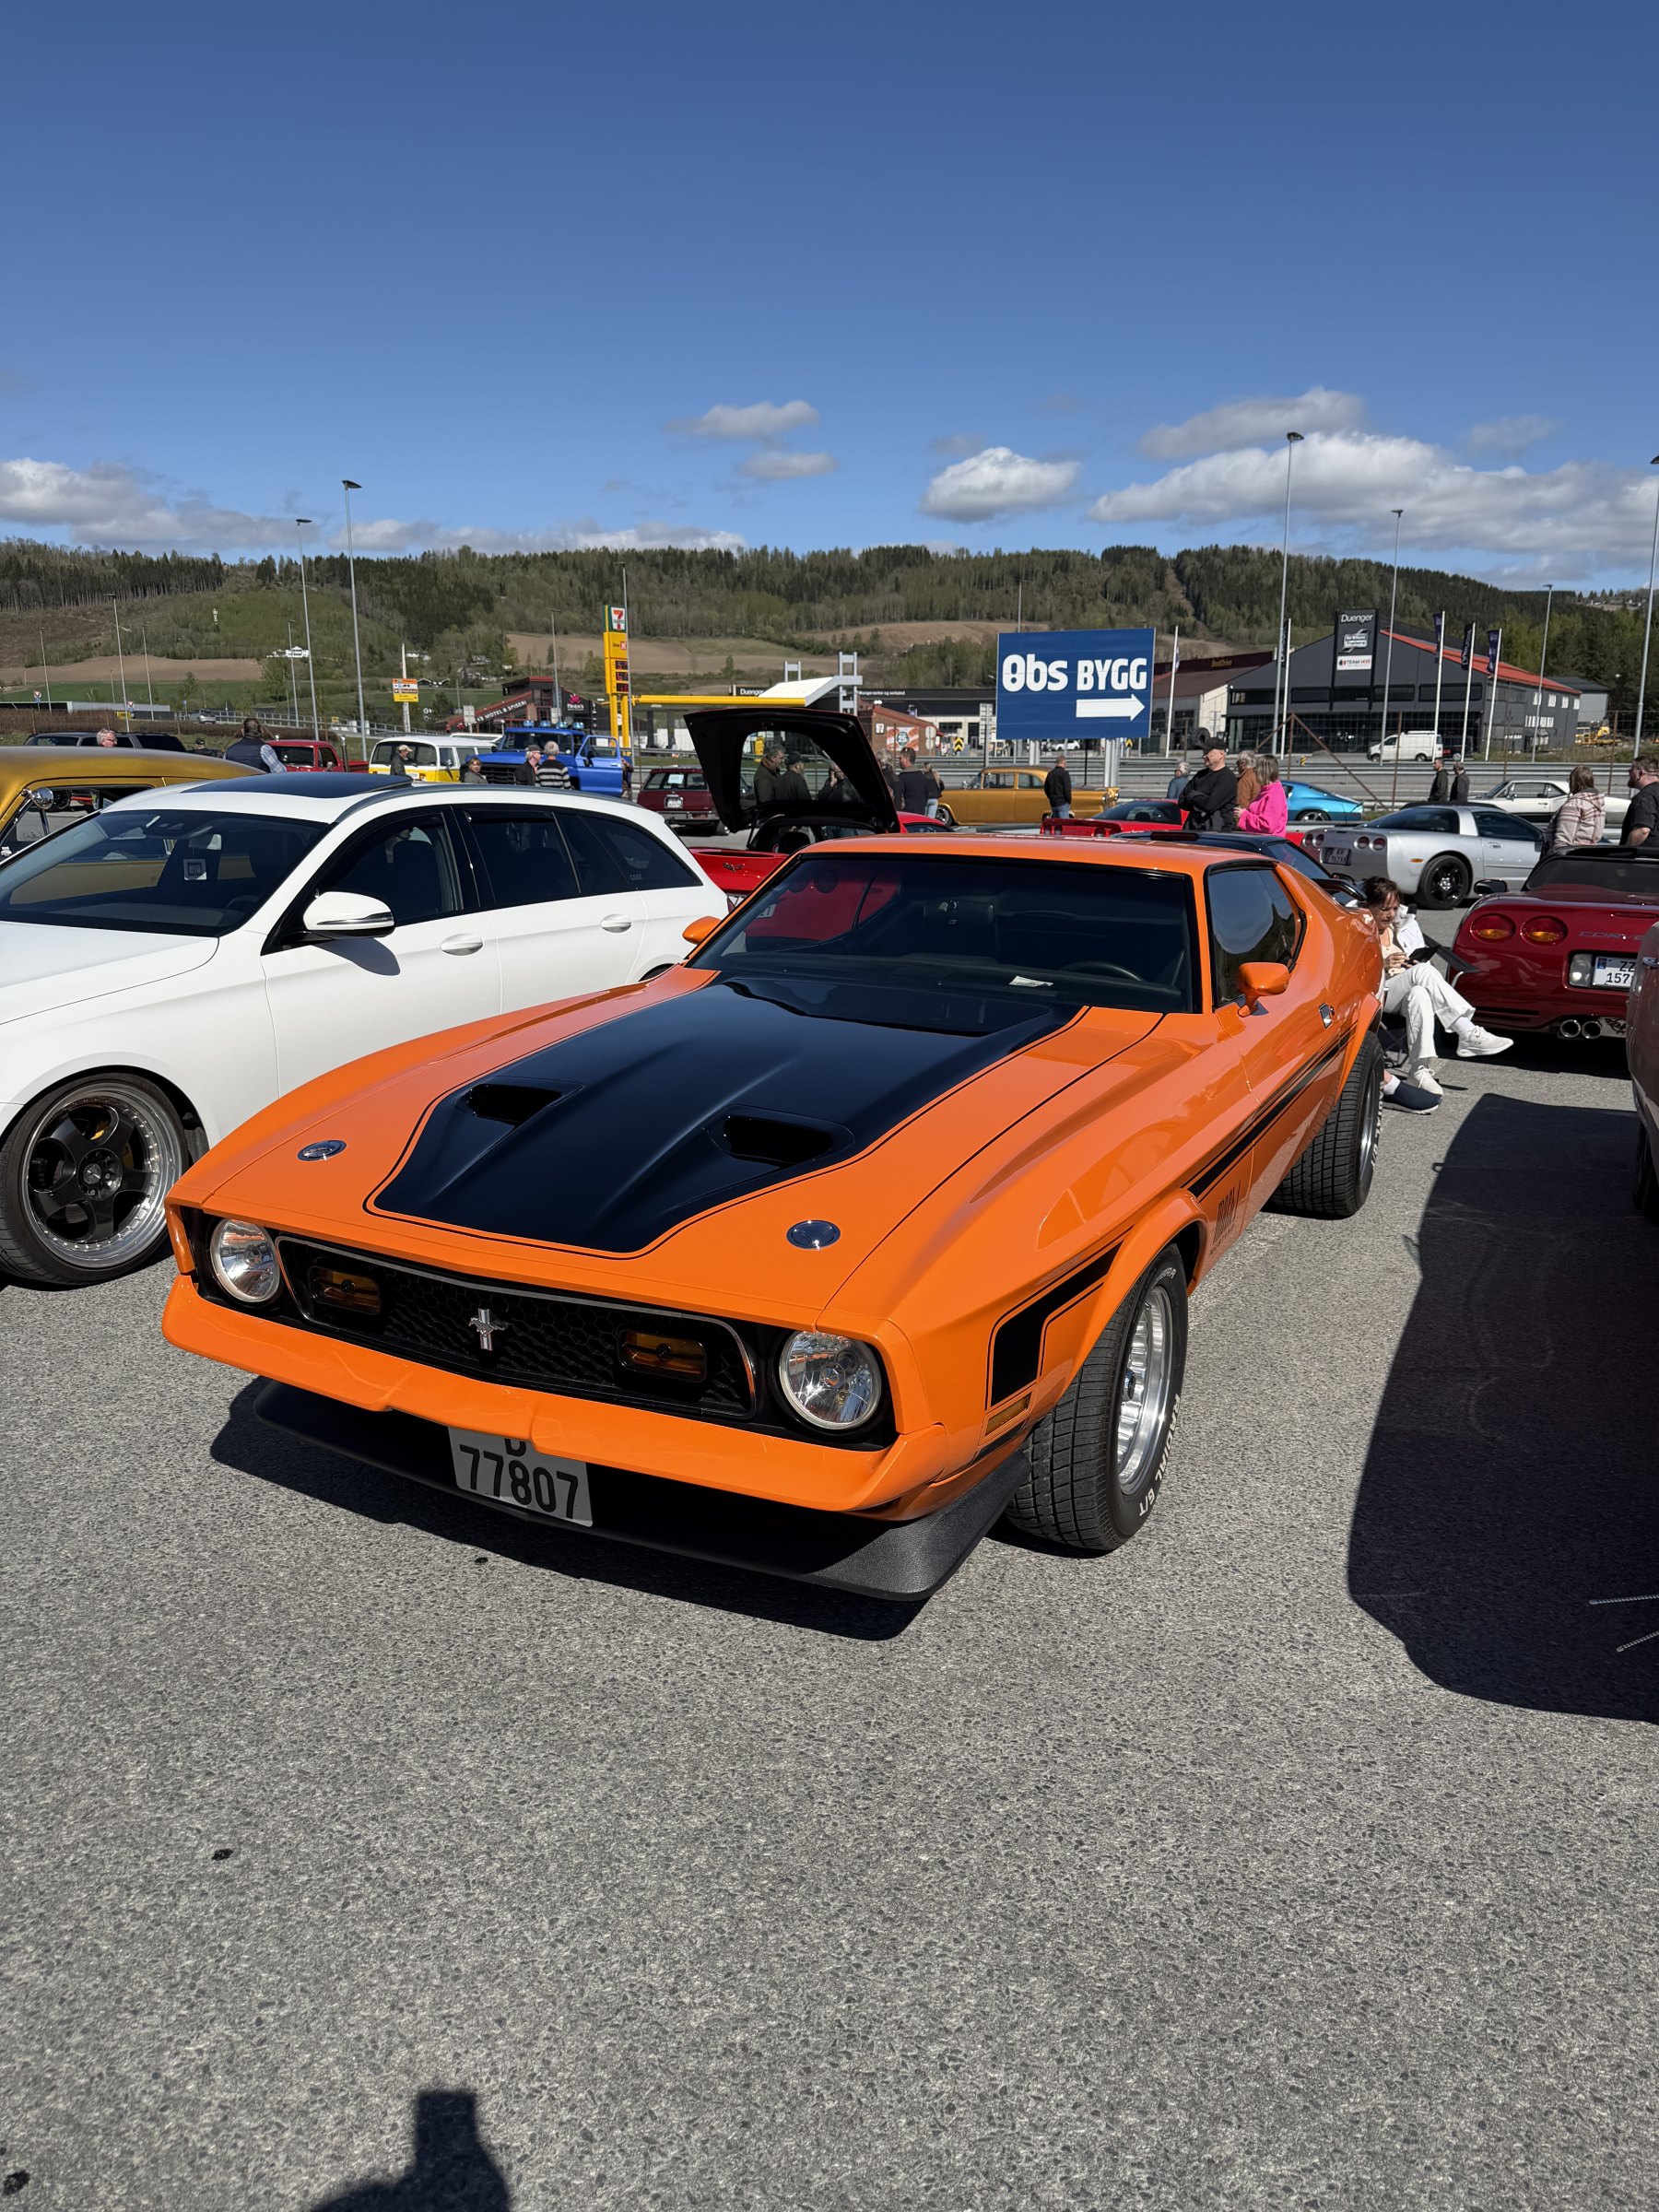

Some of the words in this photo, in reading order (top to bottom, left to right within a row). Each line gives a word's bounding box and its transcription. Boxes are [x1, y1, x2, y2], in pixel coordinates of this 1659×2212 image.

[1341, 614, 1373, 623] Duenger
[1002, 653, 1068, 692] Obs
[1077, 658, 1147, 690] BYGG
[1606, 972, 1633, 984] 157
[1155, 1393, 1180, 1481] RADIAL
[459, 1443, 578, 1520] 77807
[1139, 1488, 1155, 1516] G/T
